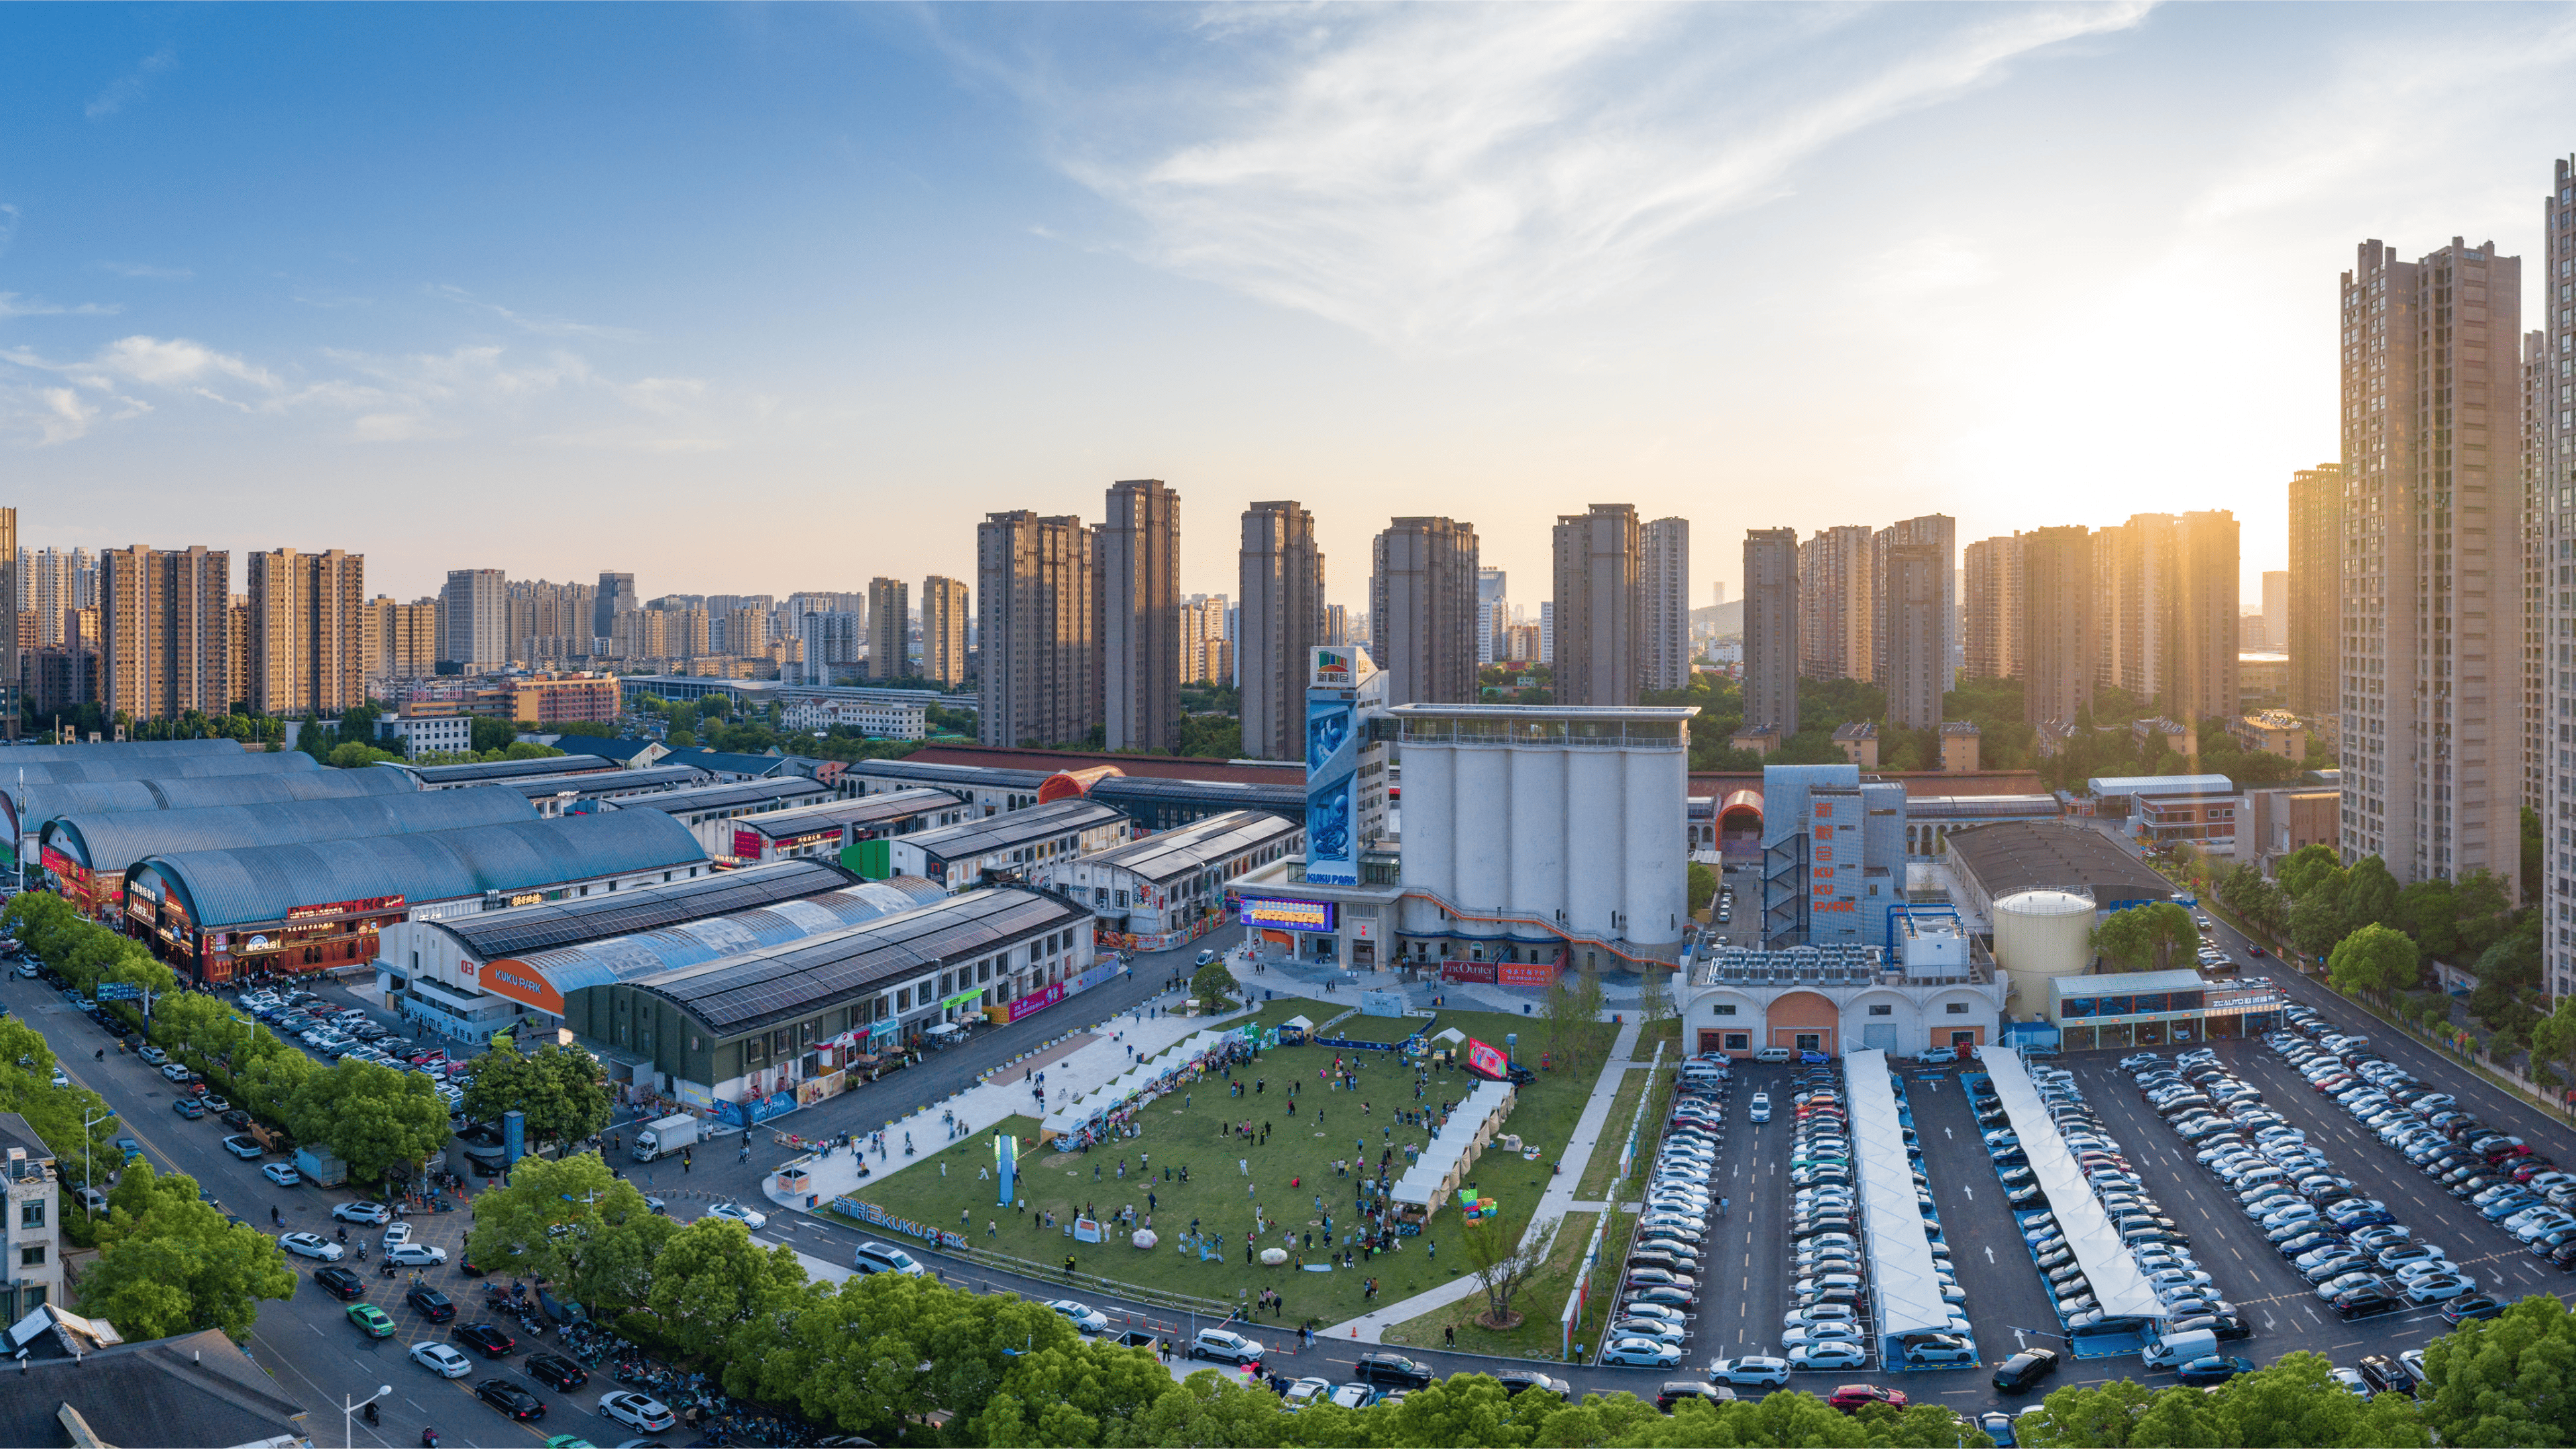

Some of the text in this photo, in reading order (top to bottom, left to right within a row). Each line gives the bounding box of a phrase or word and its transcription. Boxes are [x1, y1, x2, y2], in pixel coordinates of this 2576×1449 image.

[1813, 867, 1833, 877] KU
[1306, 873, 1356, 886] KUKU PARK
[1813, 884, 1833, 895] KU
[1813, 900, 1856, 912] PARK
[461, 960, 474, 975] 03
[495, 969, 542, 994] KUKU PARK
[2213, 998, 2244, 1007] ZCAUTO
[882, 1213, 925, 1236] KUKU
